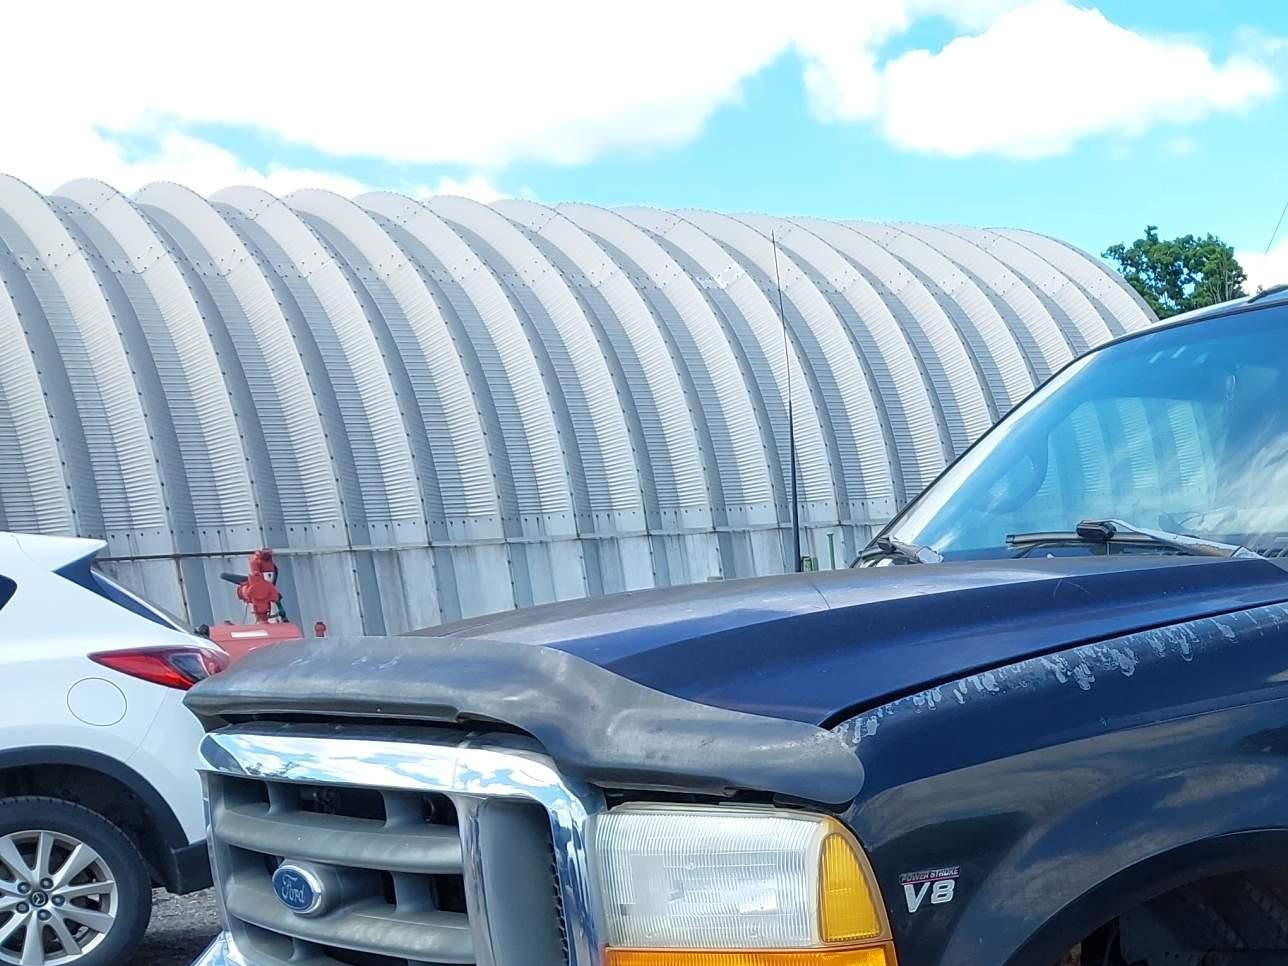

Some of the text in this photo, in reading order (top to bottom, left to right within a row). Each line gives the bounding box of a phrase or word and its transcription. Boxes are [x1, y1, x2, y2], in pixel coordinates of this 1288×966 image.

[930, 866, 960, 878] STROKE
[281, 874, 305, 904] Ford
[904, 879, 956, 913] V8
